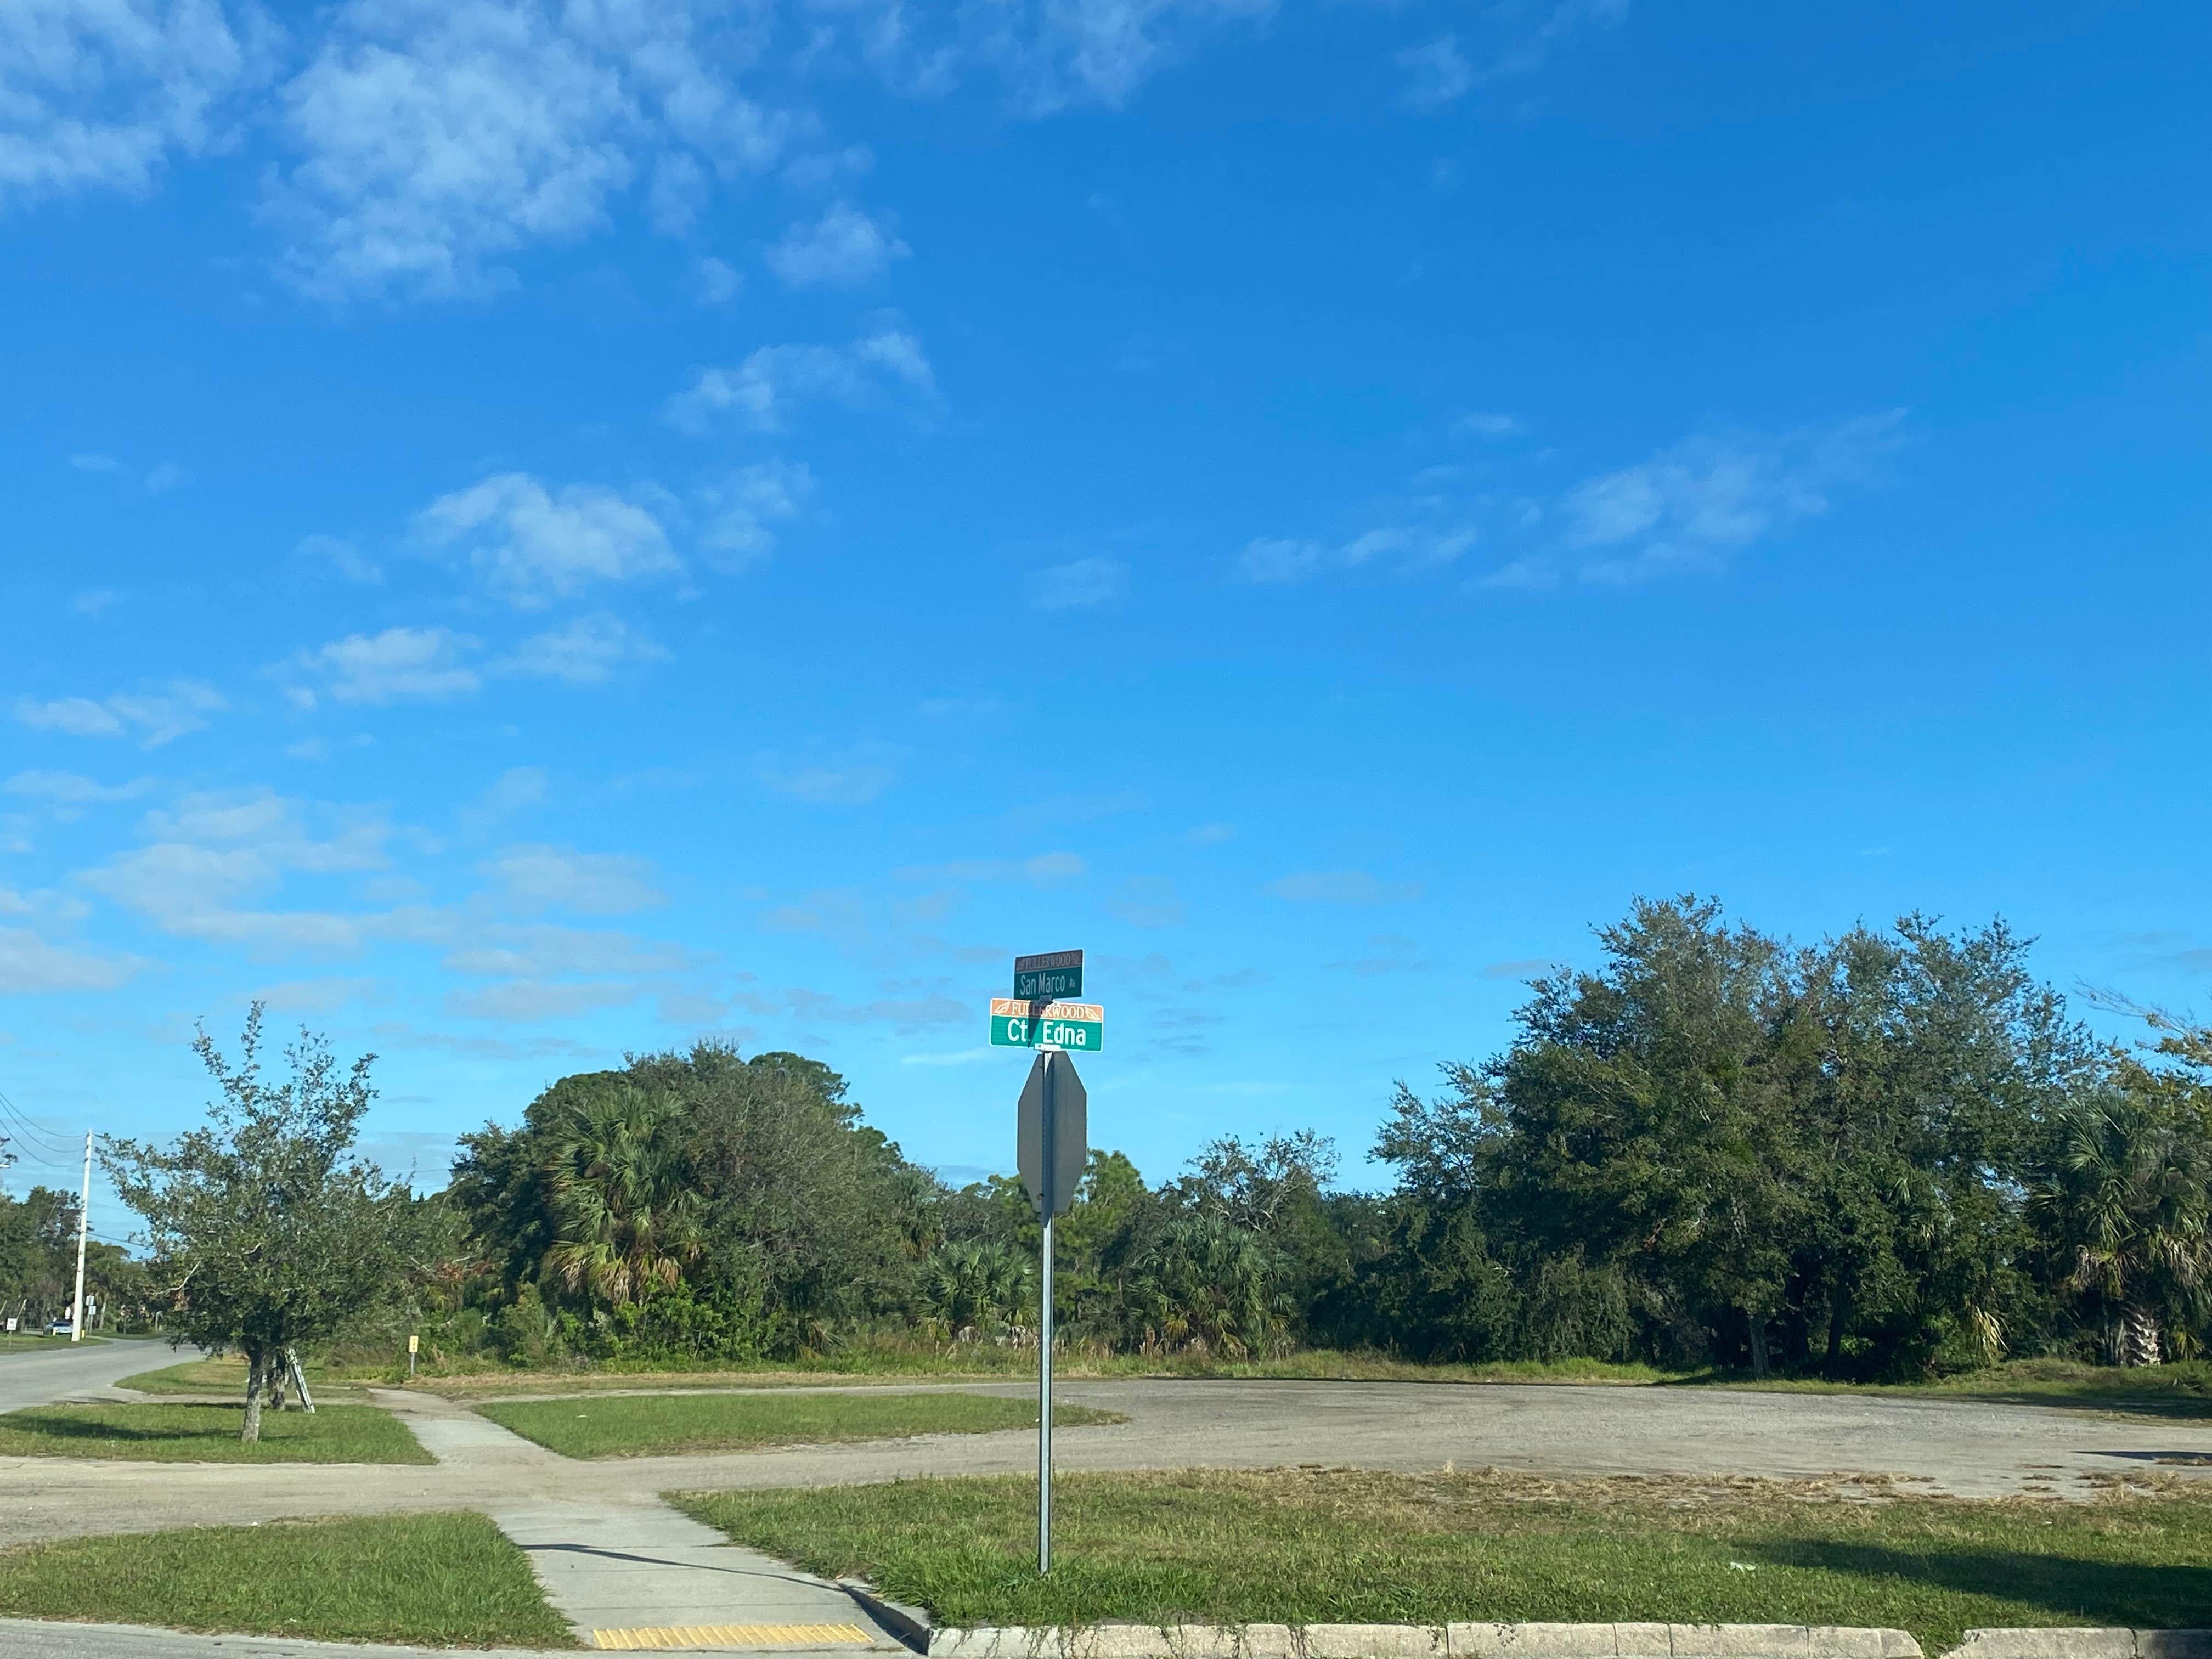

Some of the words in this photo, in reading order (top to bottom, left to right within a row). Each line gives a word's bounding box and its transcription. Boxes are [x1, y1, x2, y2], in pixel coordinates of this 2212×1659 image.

[1025, 952, 1071, 969] FULLERWOOD
[1019, 974, 1036, 996] San
[1037, 972, 1065, 994] Marco
[1042, 1020, 1086, 1046] Edna
